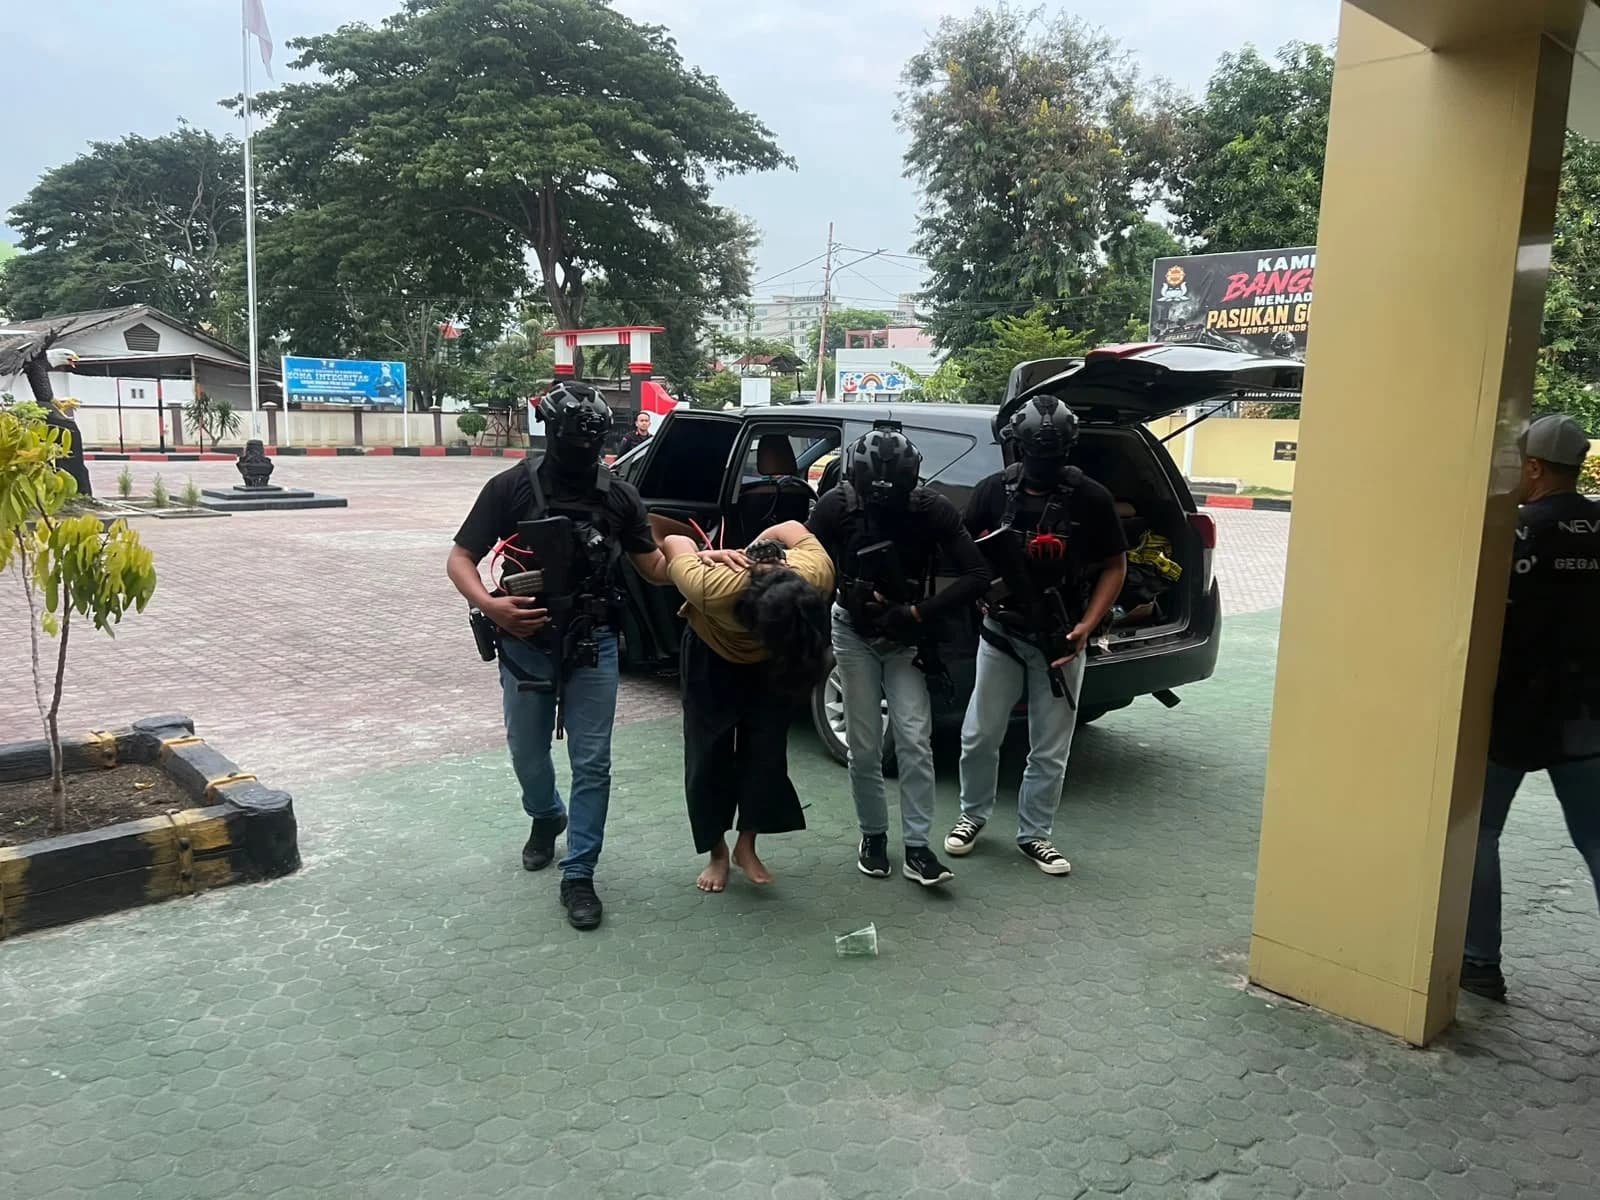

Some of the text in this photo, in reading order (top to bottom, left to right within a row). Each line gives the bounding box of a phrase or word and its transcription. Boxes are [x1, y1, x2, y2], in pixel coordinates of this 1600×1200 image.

[1257, 255, 1316, 272] KAMI
[1222, 268, 1313, 302] BANG
[1206, 305, 1289, 329] PASUKAN
[1240, 324, 1307, 335] KORPS BRIMOB
[288, 371, 313, 380] ZONA
[316, 373, 369, 383] INTEGRITAS
